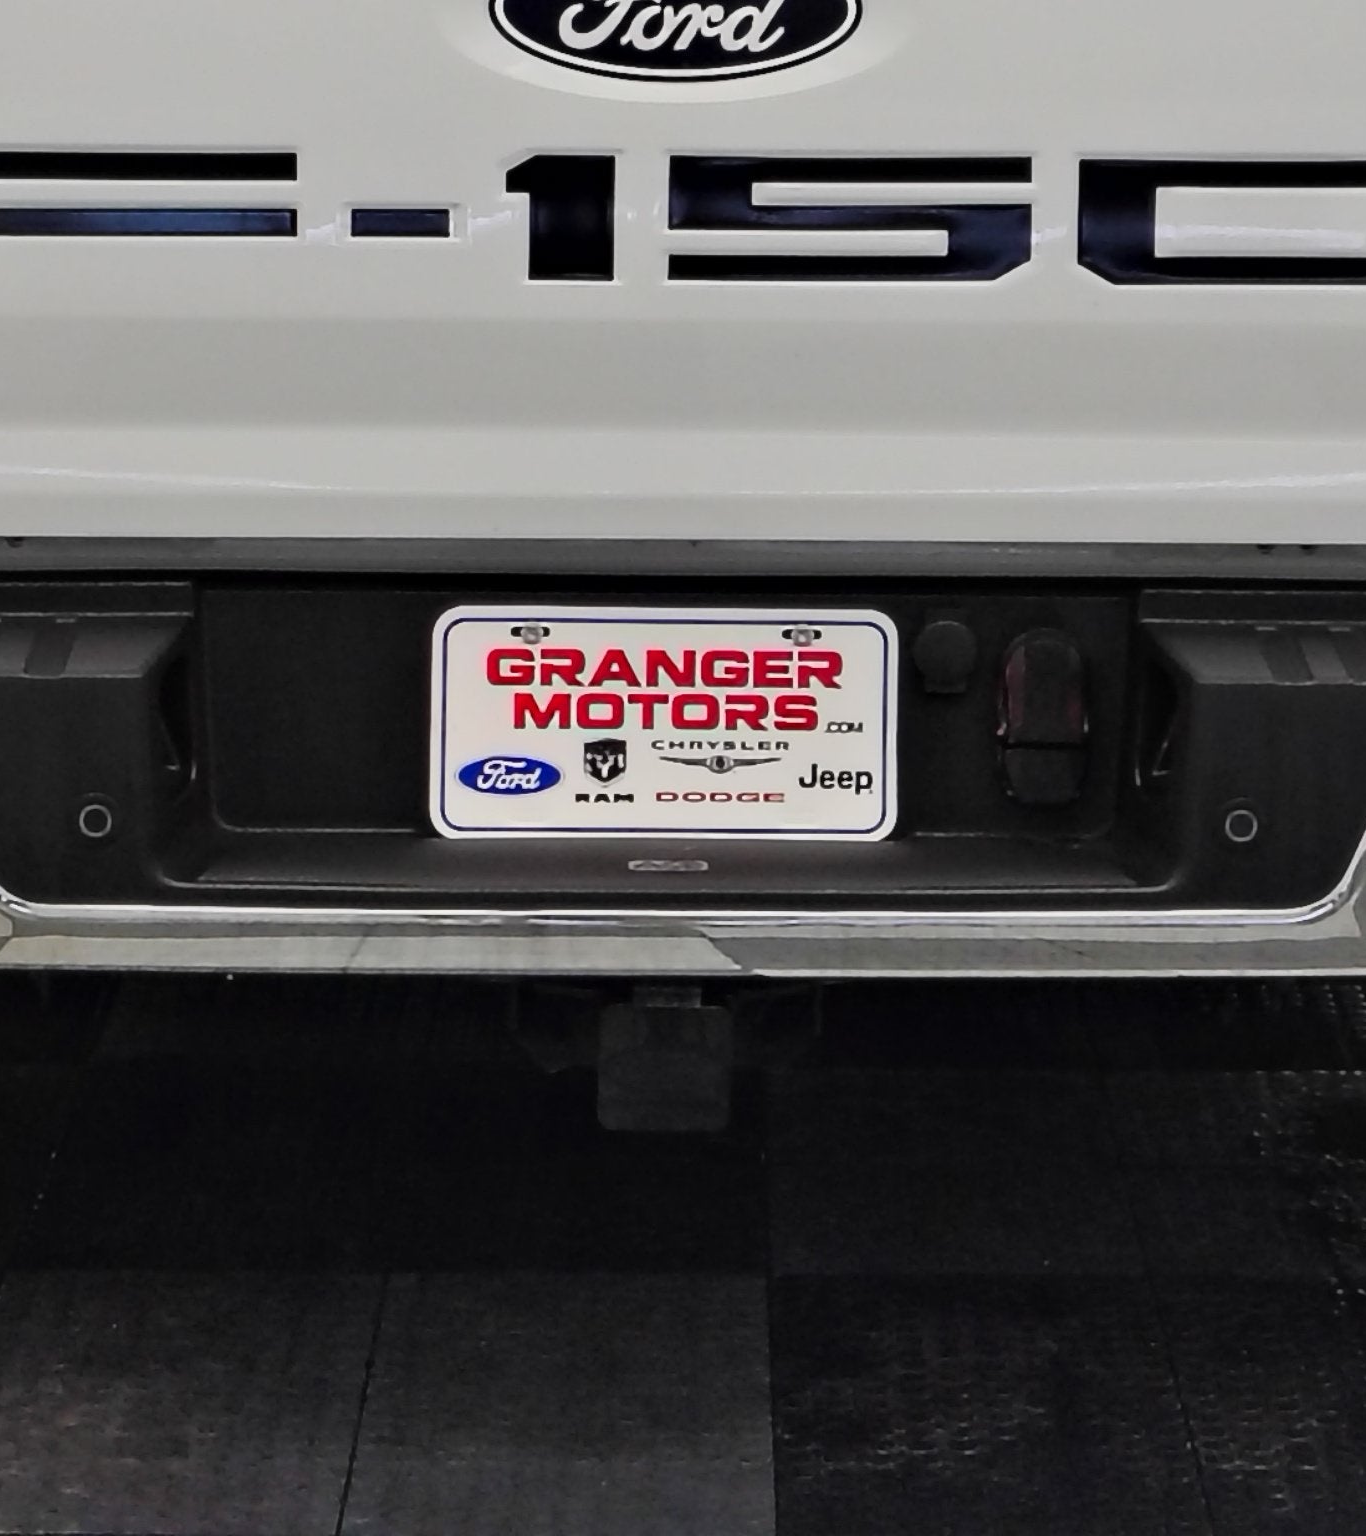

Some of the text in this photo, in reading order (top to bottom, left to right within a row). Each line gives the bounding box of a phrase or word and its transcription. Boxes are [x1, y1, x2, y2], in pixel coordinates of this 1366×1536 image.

[486, 648, 843, 689] GRANGER
[513, 692, 818, 731] MOTORS
[651, 739, 789, 751] CHRYSLER
[476, 760, 541, 790] Ford
[798, 763, 873, 795] Jeep
[575, 793, 634, 803] RAM
[655, 791, 785, 802] DODGE
